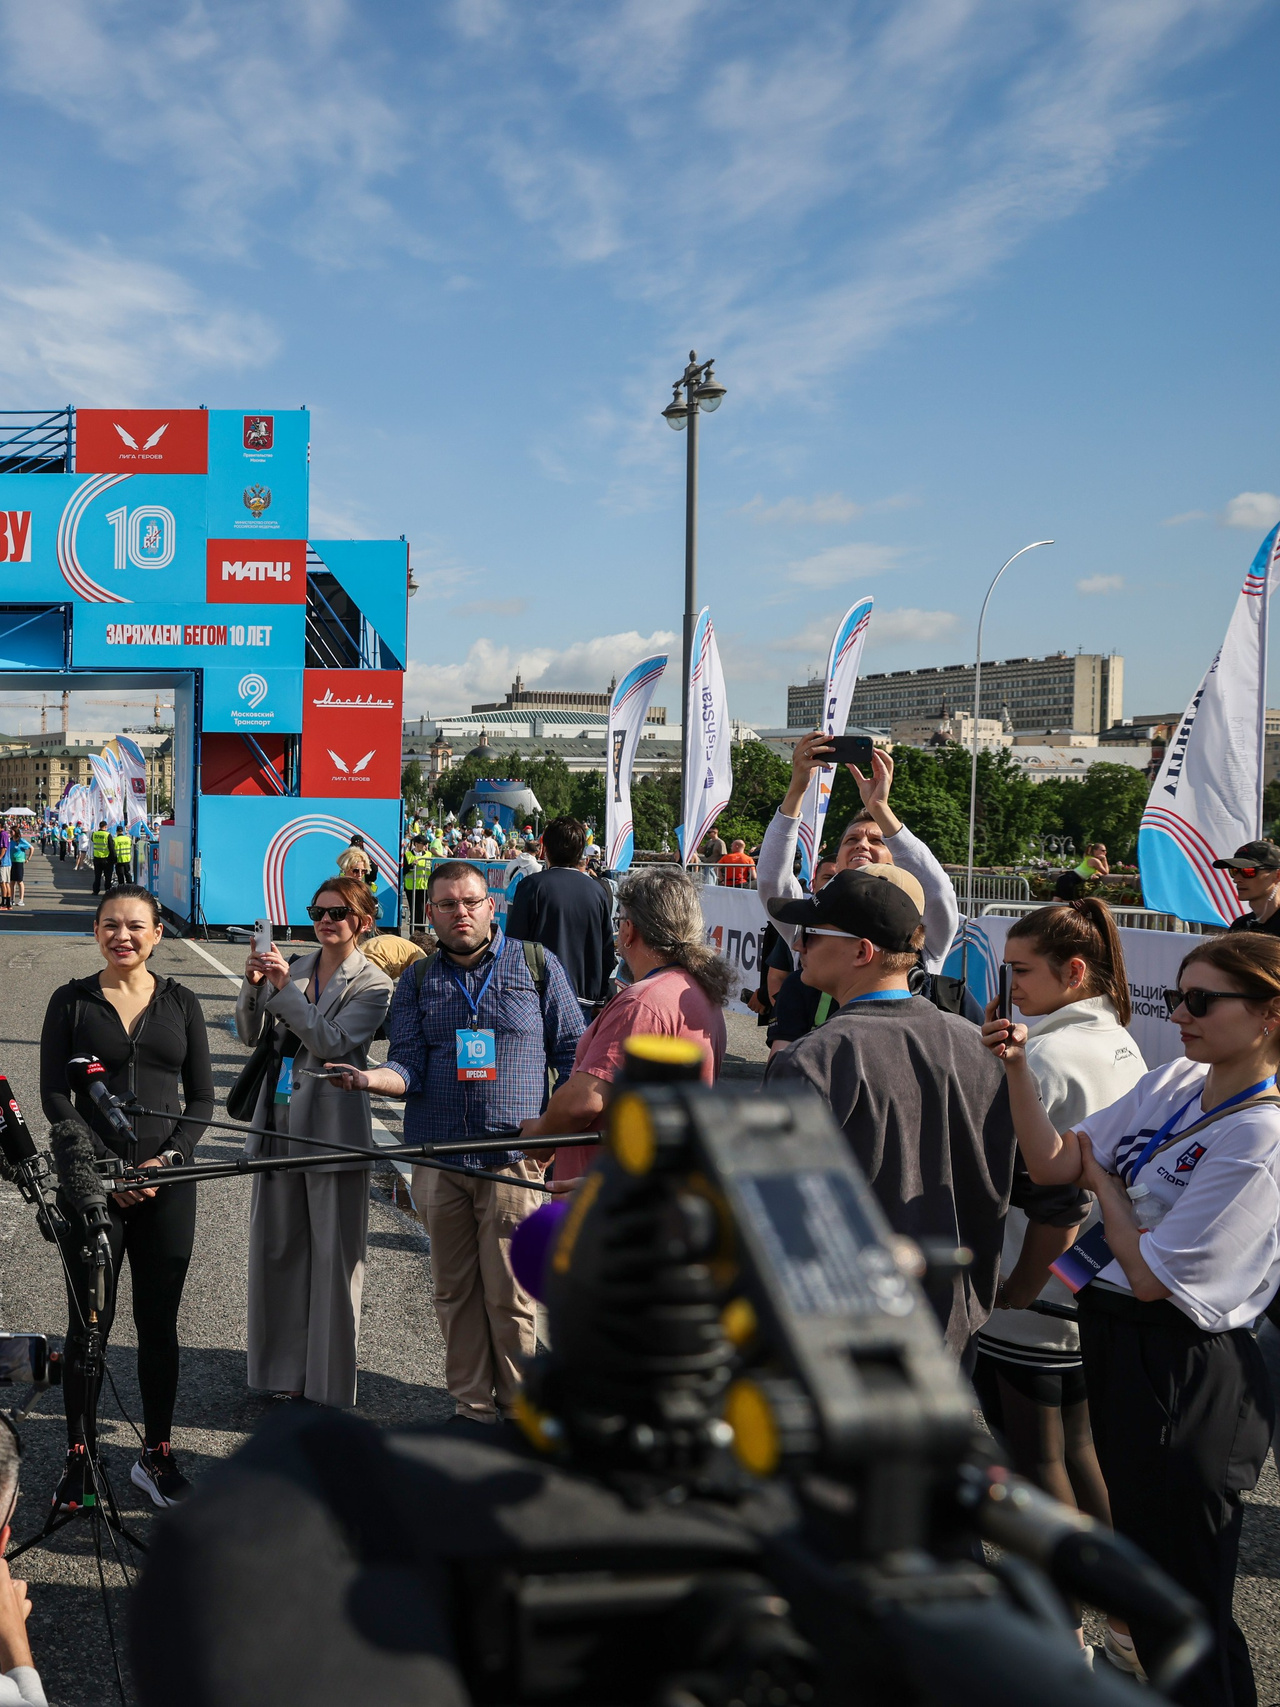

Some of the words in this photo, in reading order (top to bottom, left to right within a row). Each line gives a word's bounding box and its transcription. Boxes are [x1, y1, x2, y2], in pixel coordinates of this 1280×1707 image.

[105, 505, 176, 569] 10
[222, 561, 291, 581] МАТЧ!
[106, 624, 181, 645] ЗАРЯЖАЕМ
[183, 625, 227, 646] БЕГОМ
[229, 625, 245, 646] 10
[246, 626, 272, 646] ЛЕТ
[231, 710, 275, 718] Московский
[234, 718, 271, 727] Транспорт
[465, 1040, 486, 1058] 10
[466, 1070, 488, 1078] ПРЕССА
[1073, 1245, 1101, 1270] ОРГАНИЗАТОР
